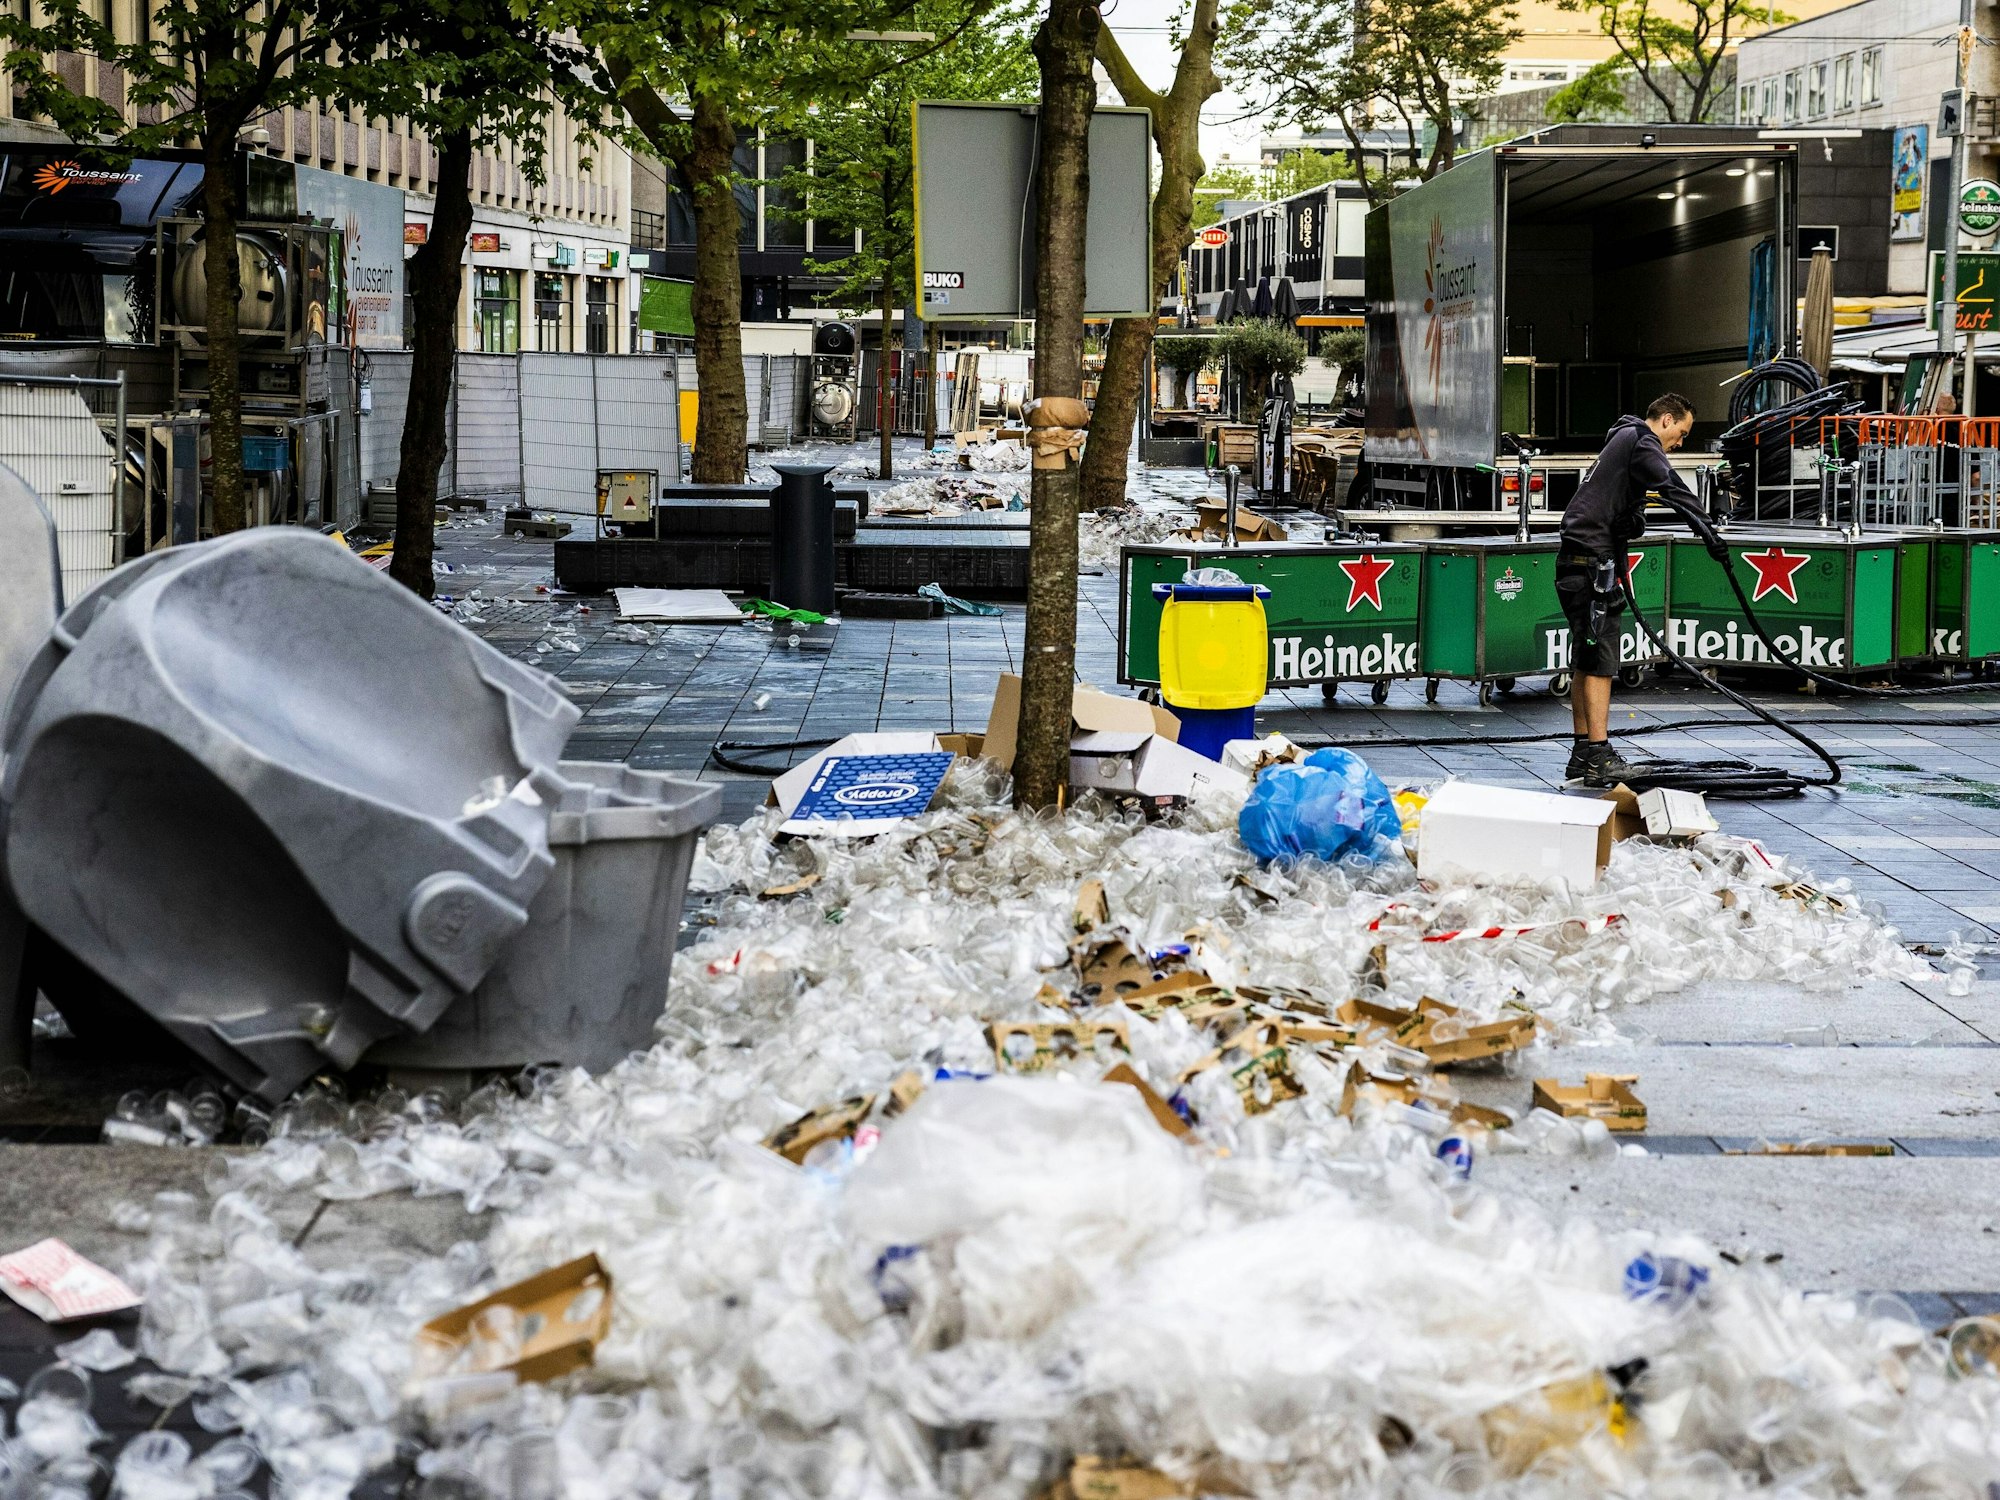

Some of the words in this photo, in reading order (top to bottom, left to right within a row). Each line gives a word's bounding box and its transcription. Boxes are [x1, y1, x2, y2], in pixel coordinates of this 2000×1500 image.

[62, 167, 144, 181] Toussaint
[1959, 202, 2000, 213] Heineke
[1303, 207, 1313, 249] COSMO
[351, 256, 393, 294] Toussaint
[923, 272, 961, 288] BUKO
[1435, 256, 1476, 303] Toussaint
[358, 296, 392, 312] evenementen
[357, 315, 377, 330] service
